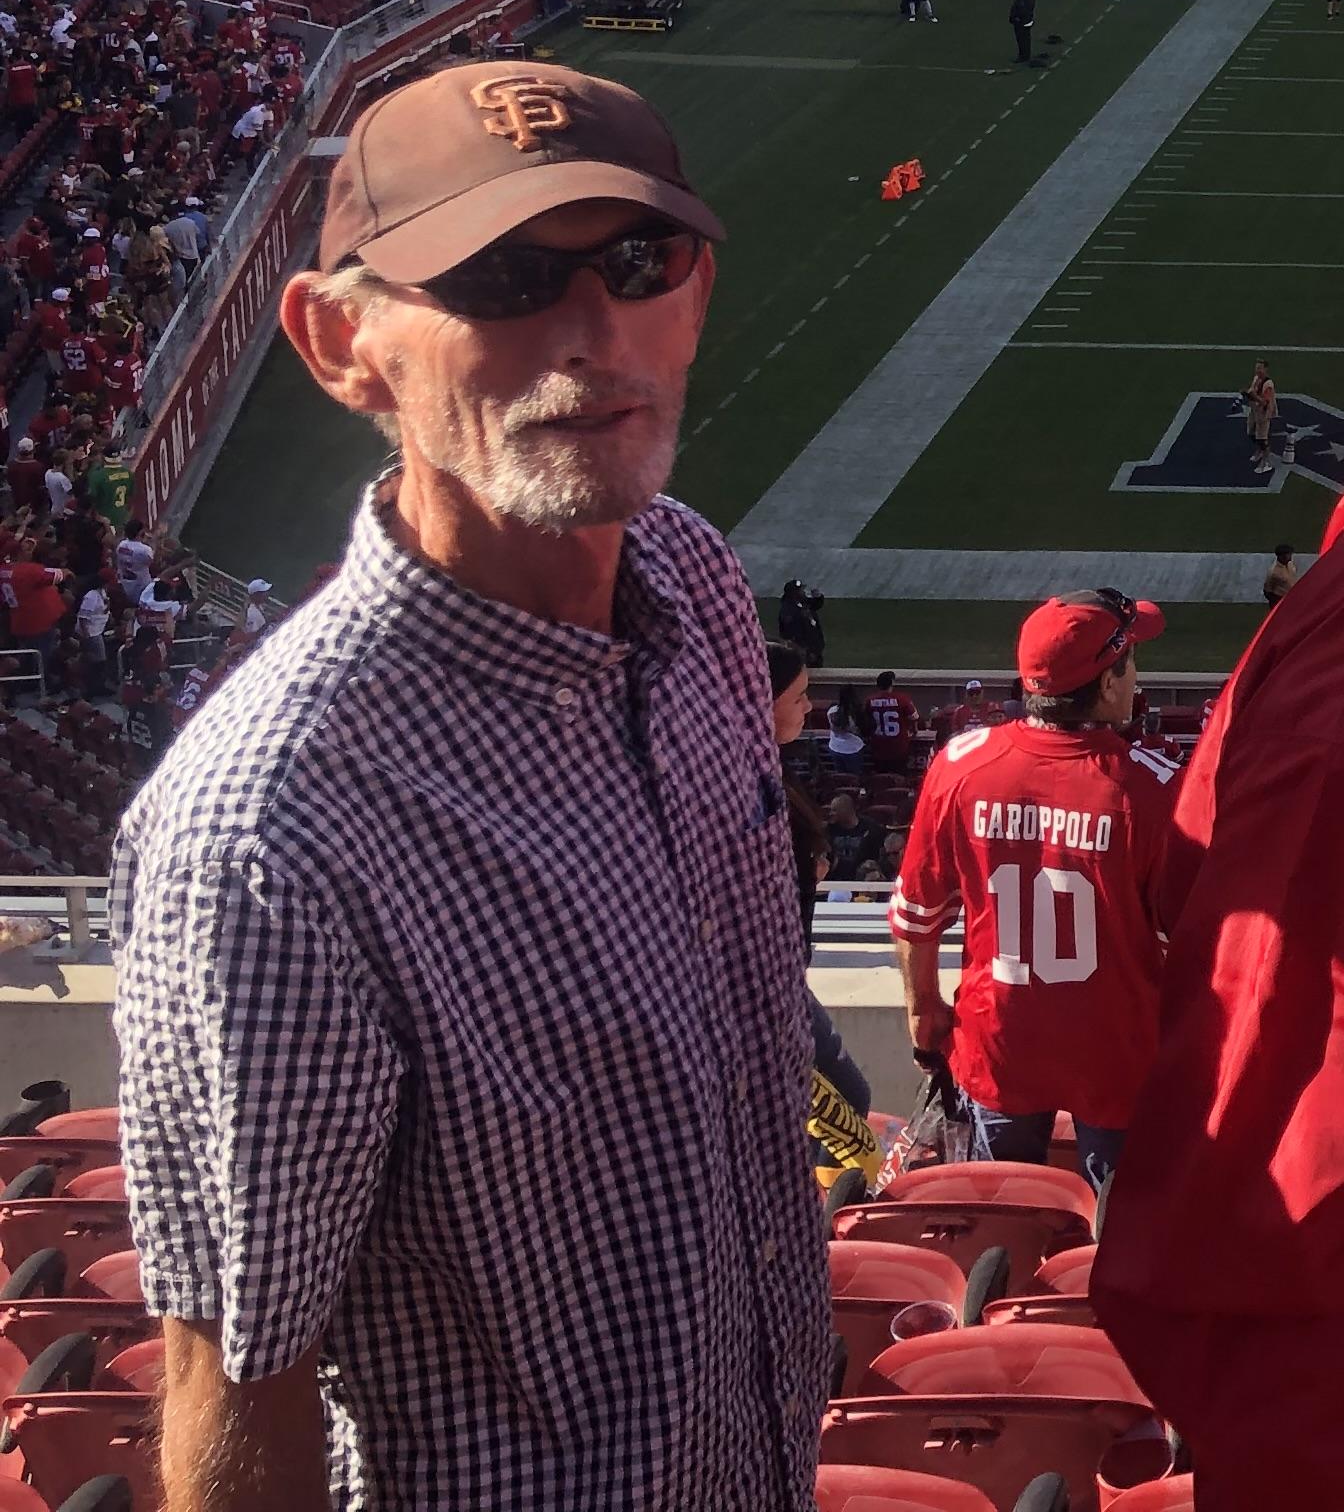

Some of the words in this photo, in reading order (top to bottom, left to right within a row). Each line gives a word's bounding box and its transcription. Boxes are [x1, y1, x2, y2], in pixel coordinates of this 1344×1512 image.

[469, 75, 574, 153] SF
[145, 386, 196, 530] HOME
[221, 208, 288, 377] FAITHFUL
[871, 710, 900, 737] 16
[973, 799, 1113, 852] GAROPPOLO
[987, 863, 1098, 986] 10
